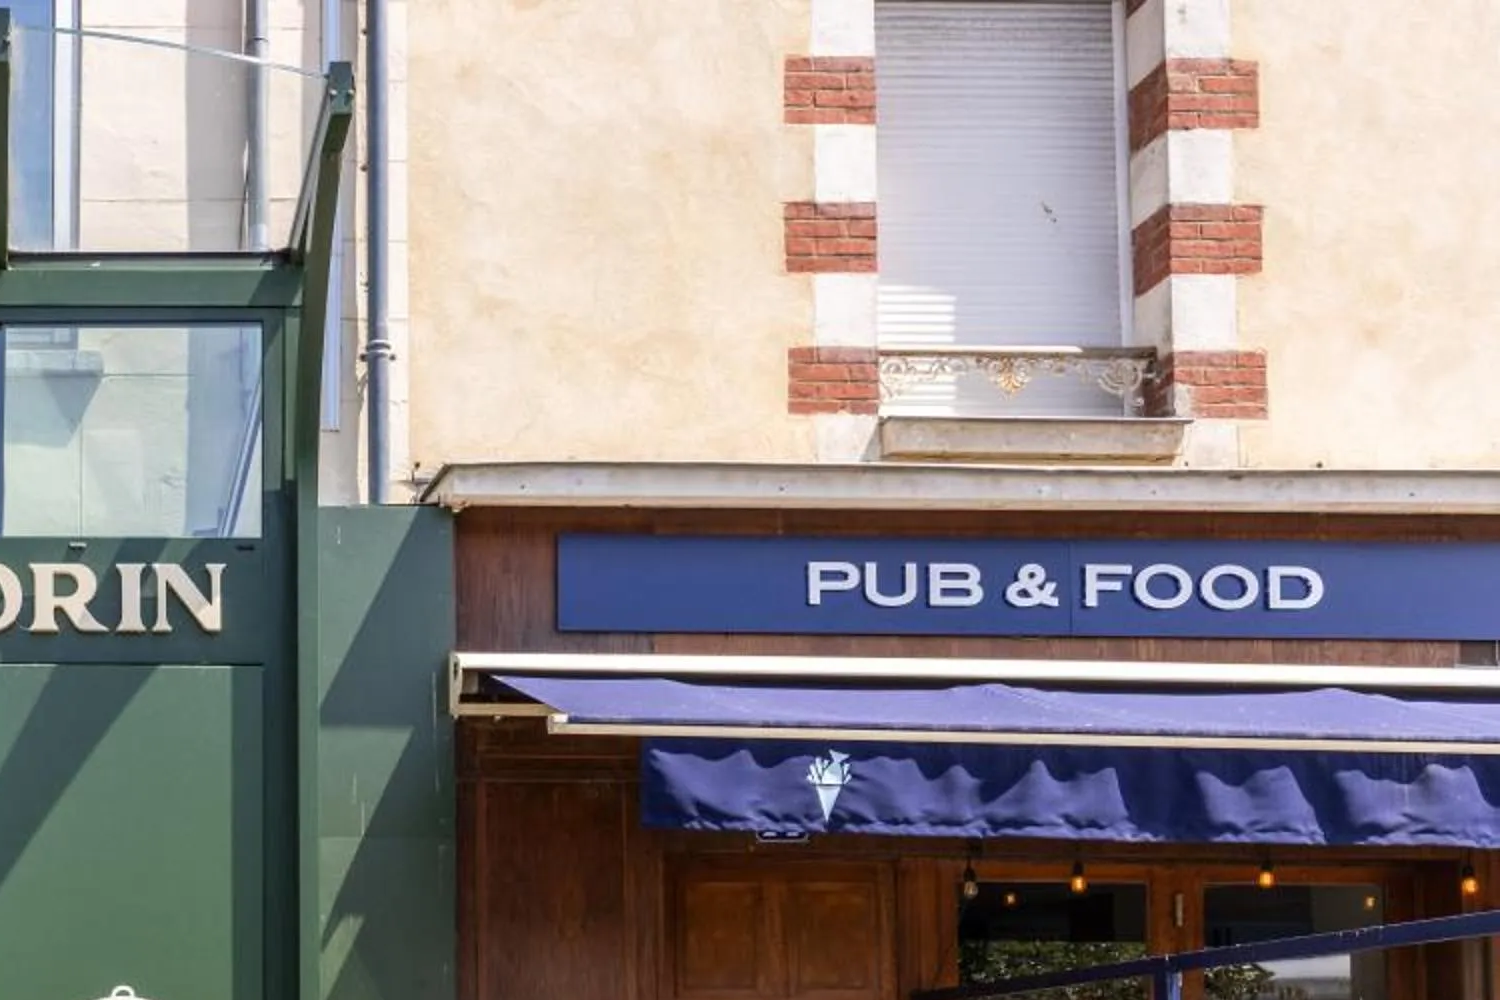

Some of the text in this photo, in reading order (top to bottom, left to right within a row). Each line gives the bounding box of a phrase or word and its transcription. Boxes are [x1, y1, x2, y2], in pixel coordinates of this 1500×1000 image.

[807, 561, 1325, 611] PUB & FOOD
